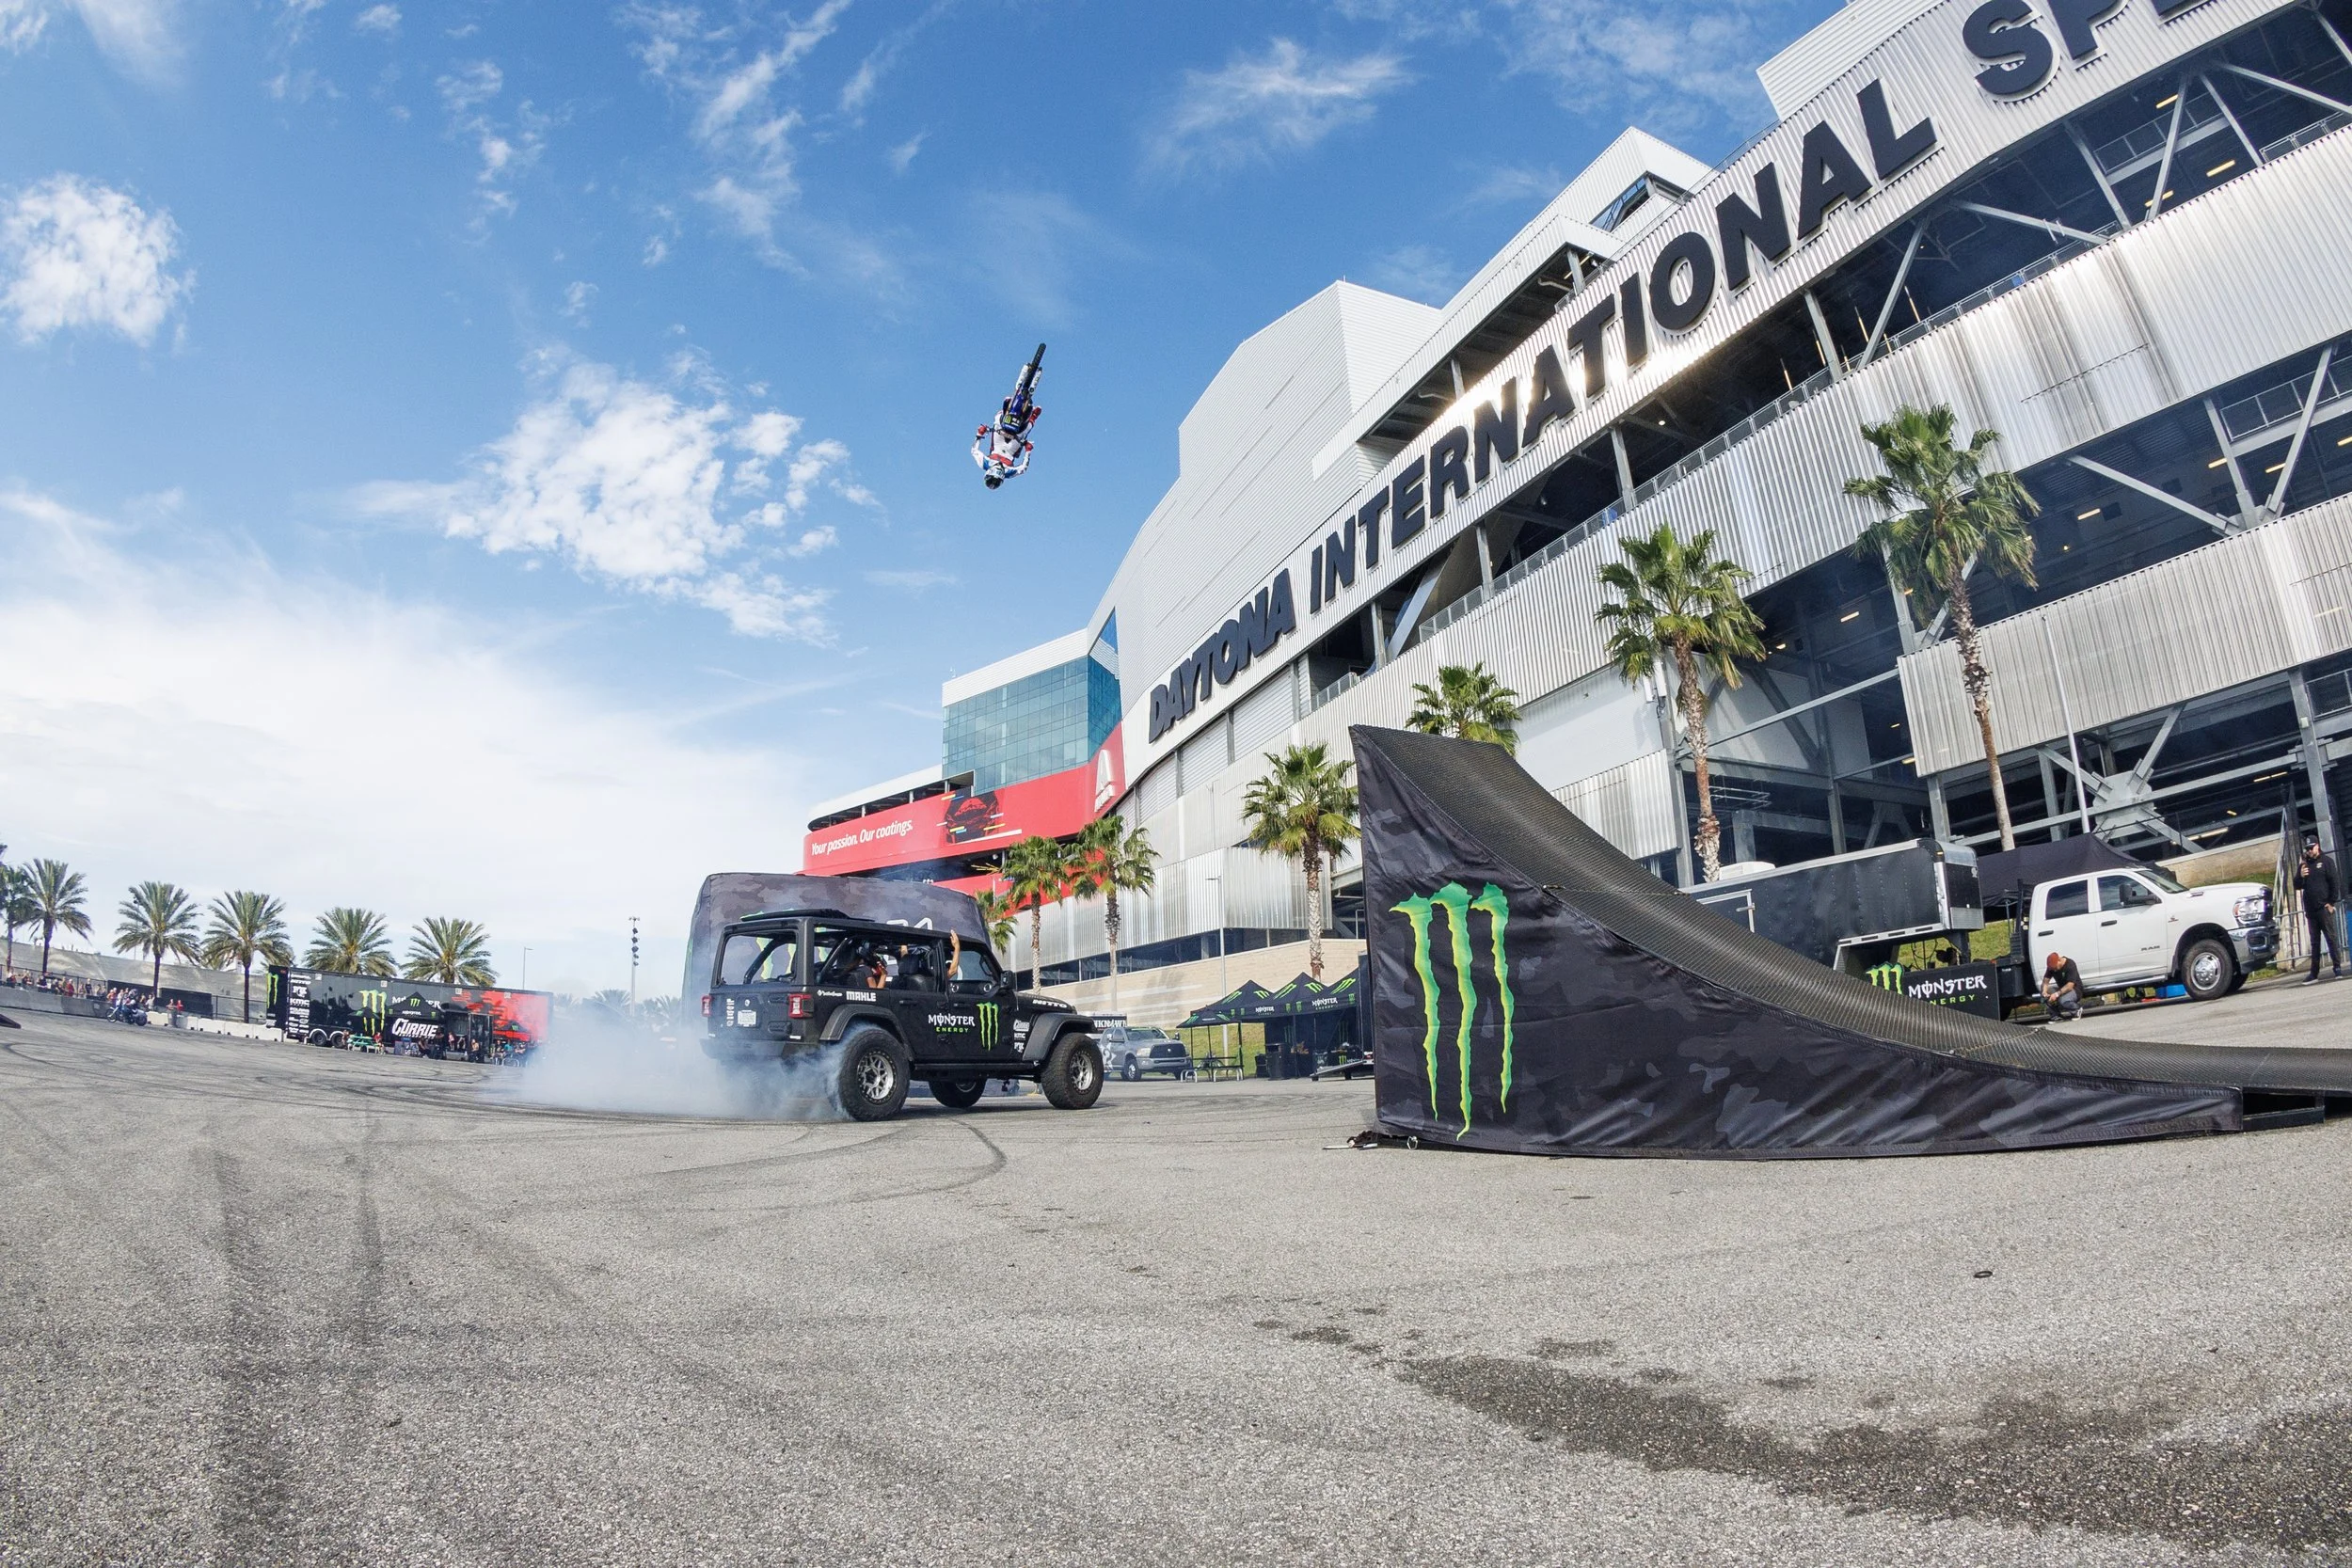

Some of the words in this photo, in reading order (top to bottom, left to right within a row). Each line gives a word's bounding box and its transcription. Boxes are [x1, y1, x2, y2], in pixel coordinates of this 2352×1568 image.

[1149, 568, 1295, 743] DAYTONA
[1310, 78, 1937, 614] INTERNATIONAL
[811, 843, 828, 855] Your
[827, 834, 858, 854] passion.
[860, 829, 874, 843] Our
[876, 819, 914, 836] coatings.
[1908, 974, 1987, 998] MONSTER
[846, 990, 876, 1002] MAHLE
[1032, 999, 1068, 1008] NITTO
[1929, 994, 1975, 1006] NERGY
[392, 1018, 438, 1037] CURRIE
[928, 1013, 976, 1026] MONSTER
